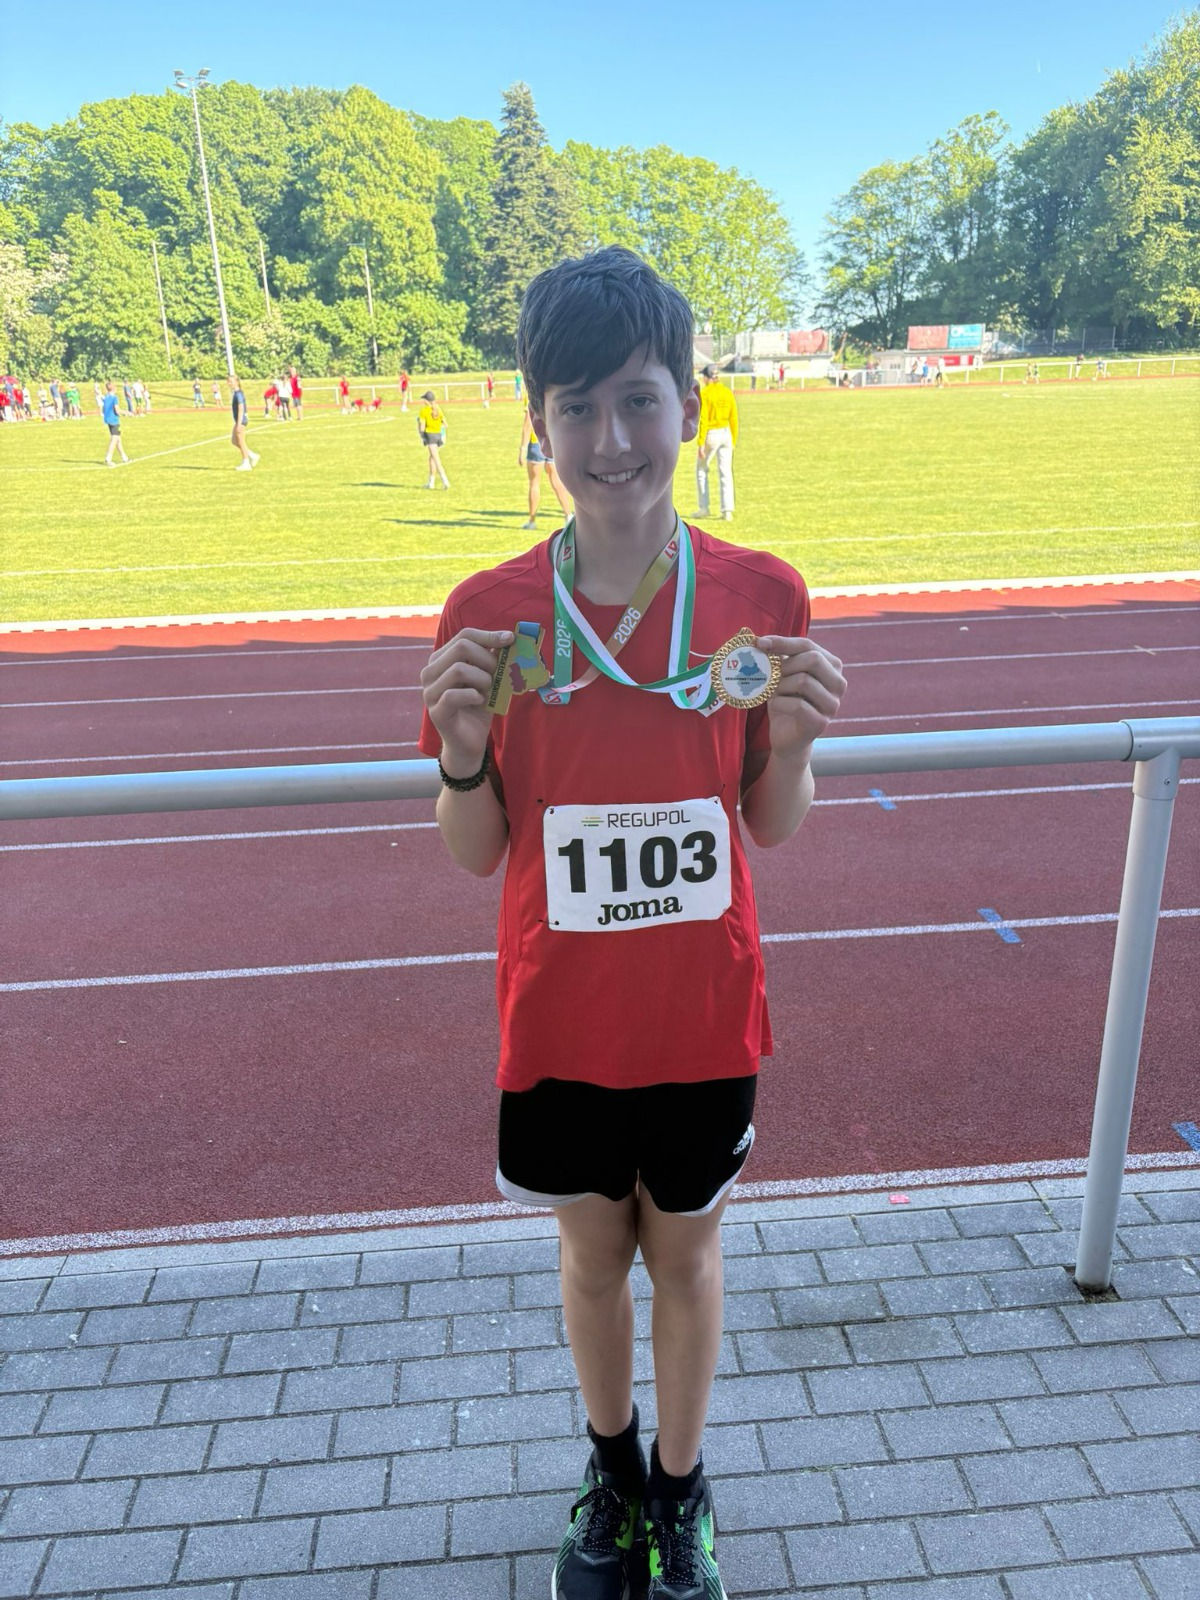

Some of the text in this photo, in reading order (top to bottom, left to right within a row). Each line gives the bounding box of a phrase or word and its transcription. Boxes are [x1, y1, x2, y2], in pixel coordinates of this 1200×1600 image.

[613, 607, 641, 644] 2026
[607, 809, 691, 828] REGUPOL
[557, 830, 718, 893] 1103
[597, 895, 683, 926] Joma
